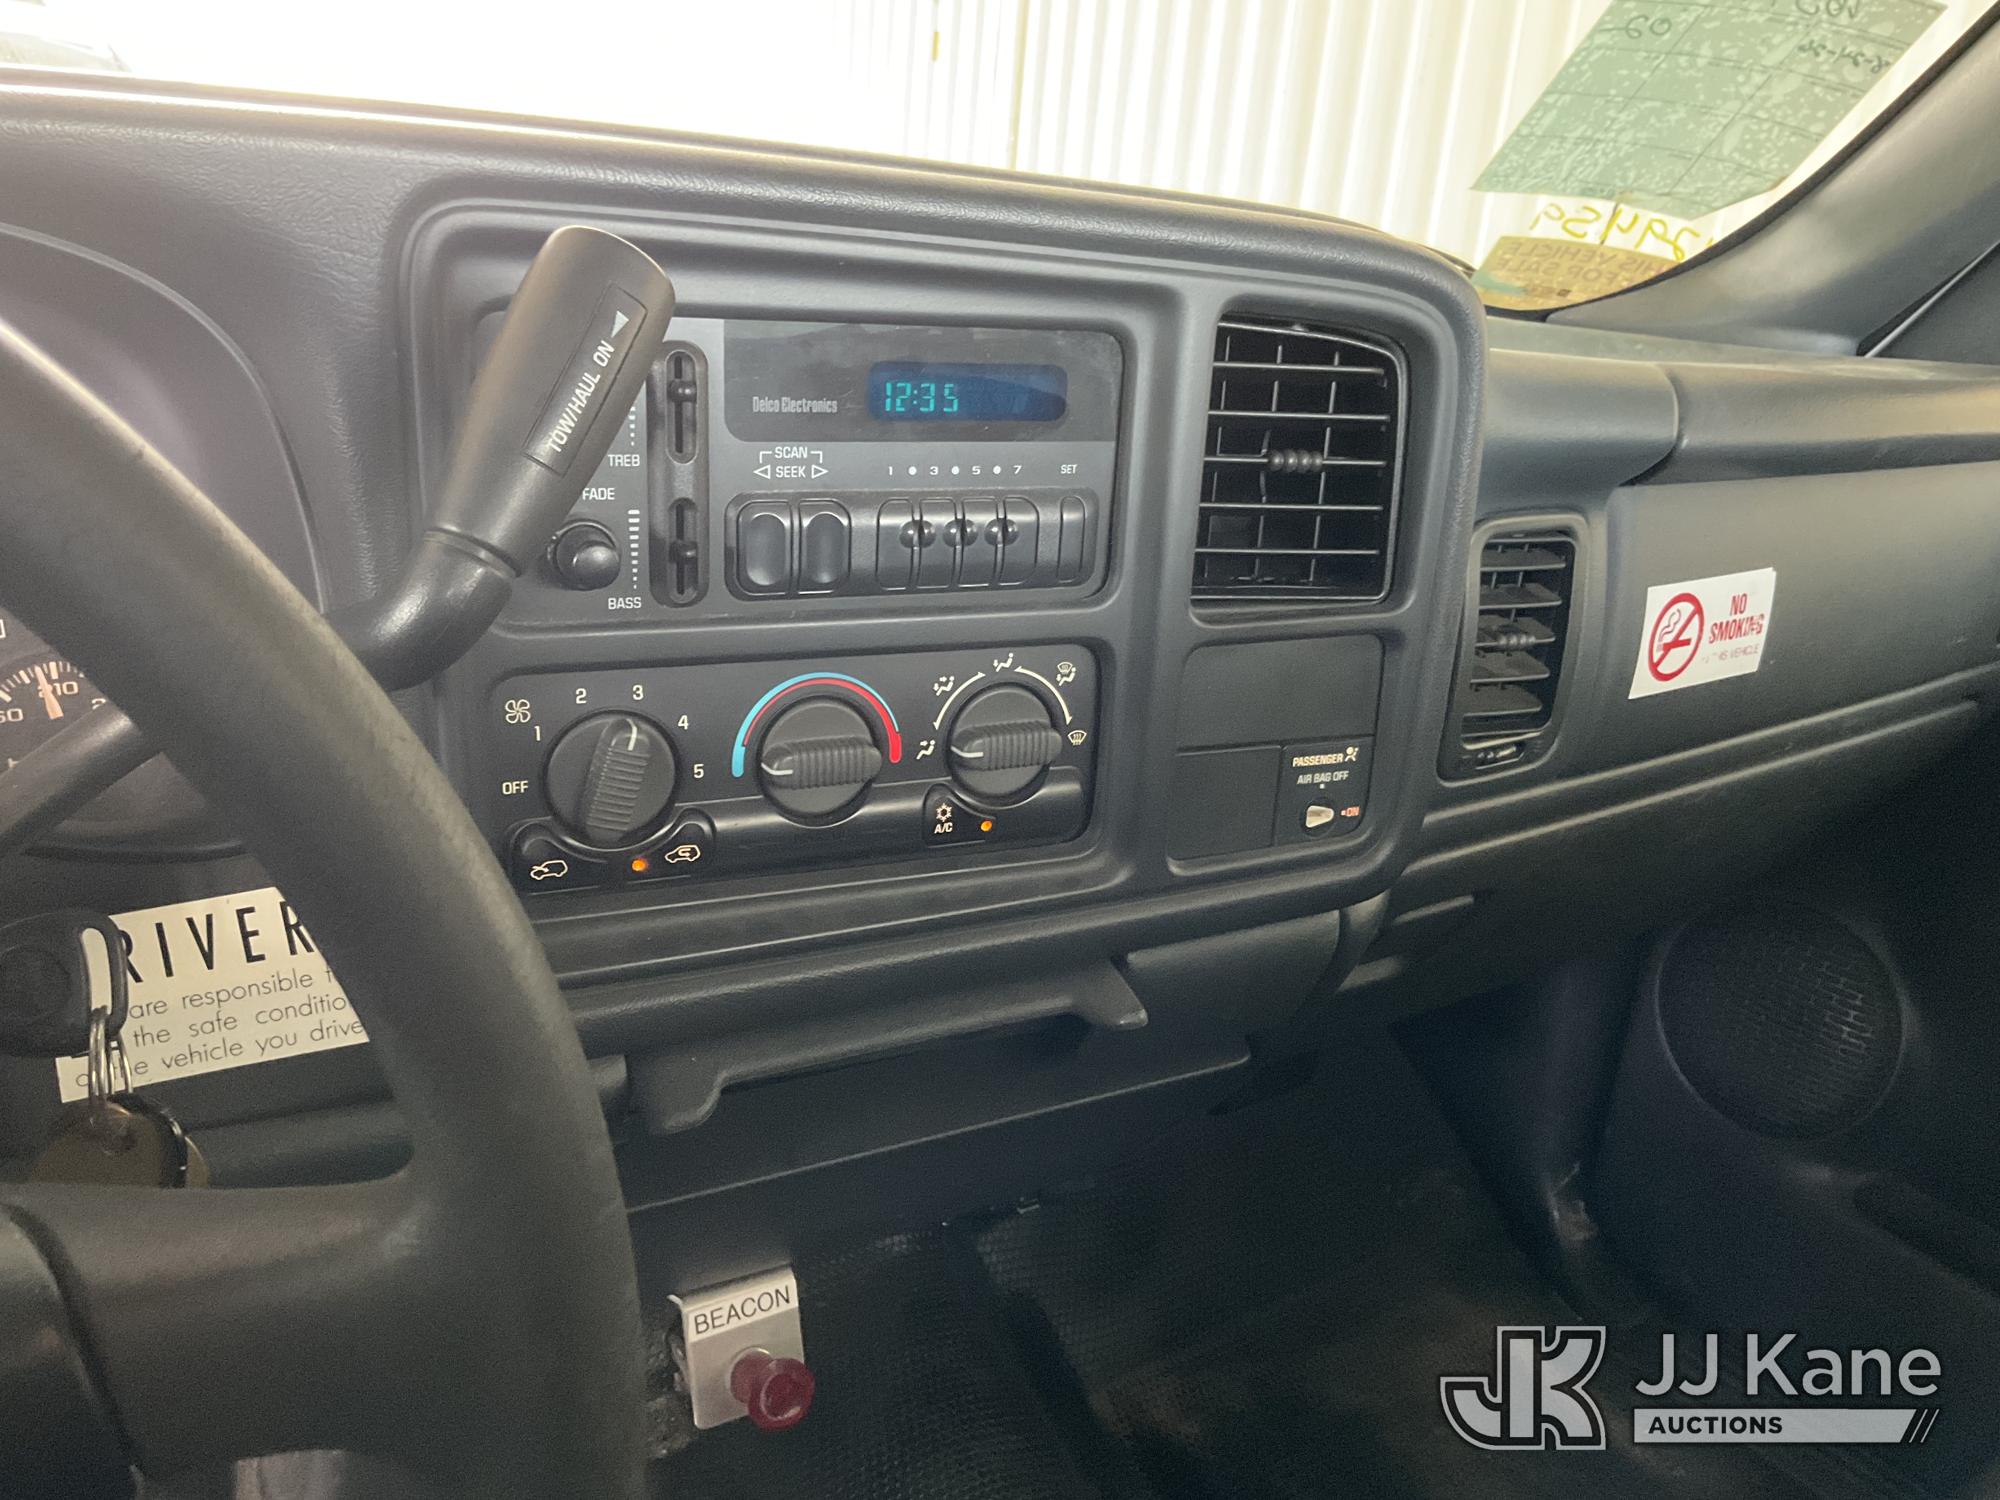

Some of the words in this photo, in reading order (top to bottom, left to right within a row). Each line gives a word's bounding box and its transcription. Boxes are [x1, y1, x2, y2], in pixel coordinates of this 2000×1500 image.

[546, 371, 601, 453] TOW/HAUL
[592, 340, 615, 368] ON
[752, 396, 780, 413] Delco
[781, 397, 838, 413] Electronics
[884, 382, 959, 413] 12:35
[607, 454, 641, 467] TREB
[774, 446, 808, 459] SCAN
[775, 465, 806, 479] SEEK
[929, 466, 939, 476] 3
[971, 465, 981, 476] 5
[1013, 465, 1022, 475] 7
[1060, 464, 1078, 474] SET
[582, 487, 615, 501] FADE
[607, 597, 642, 610] BASS
[1730, 593, 1748, 616] NO
[575, 688, 587, 704] 2
[632, 684, 644, 701] 3
[677, 714, 689, 730] 4
[534, 725, 541, 742] 1
[1292, 752, 1345, 768] PASSENGER
[693, 763, 705, 779] 5
[1296, 773, 1312, 785] AIR
[1313, 772, 1331, 783] BAG
[1332, 770, 1350, 781] OFF
[502, 780, 529, 795] OFF
[1346, 806, 1360, 817] ON
[933, 820, 953, 835] A/C
[117, 900, 316, 983] RIVER
[128, 1000, 168, 1019] are
[181, 969, 313, 1009] responsible
[132, 1026, 171, 1048] the
[188, 1012, 239, 1038] safe
[254, 994, 348, 1026] conditio
[161, 1036, 243, 1070] vehicle
[255, 1030, 298, 1057] you
[693, 1284, 791, 1335] BEACON
